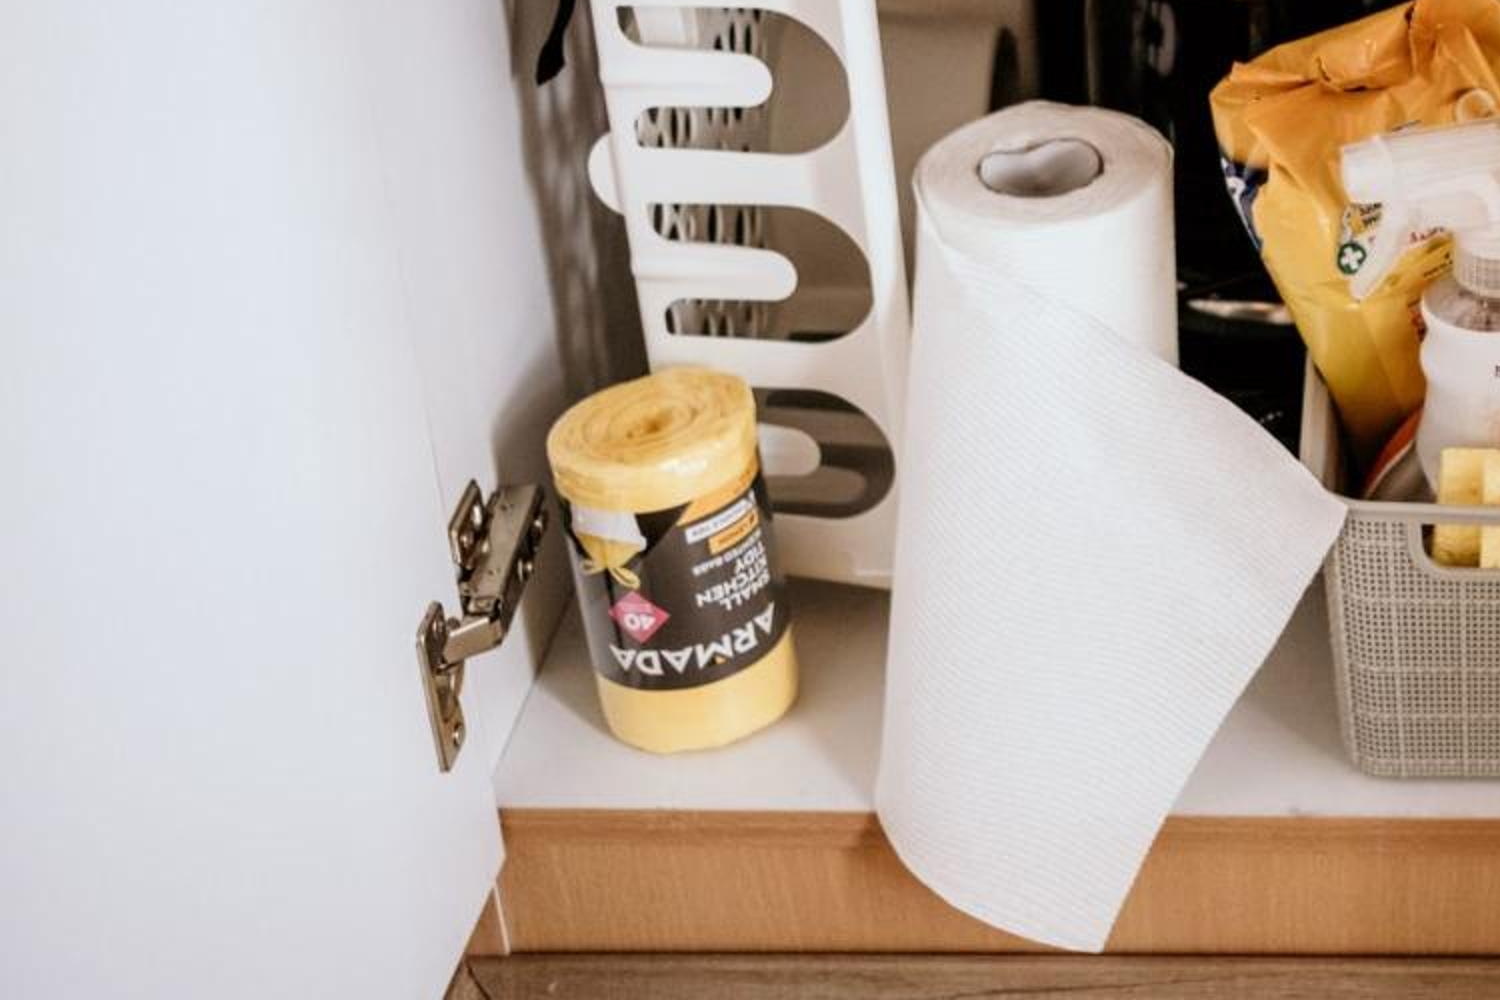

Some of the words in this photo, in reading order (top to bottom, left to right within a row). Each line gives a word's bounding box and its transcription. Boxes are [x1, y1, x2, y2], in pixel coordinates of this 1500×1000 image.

[734, 540, 766, 576] TIDY
[695, 553, 769, 608] KITCHEN
[719, 567, 770, 611] SMALL
[609, 602, 775, 676] ARMADA
[623, 611, 657, 630] 40
